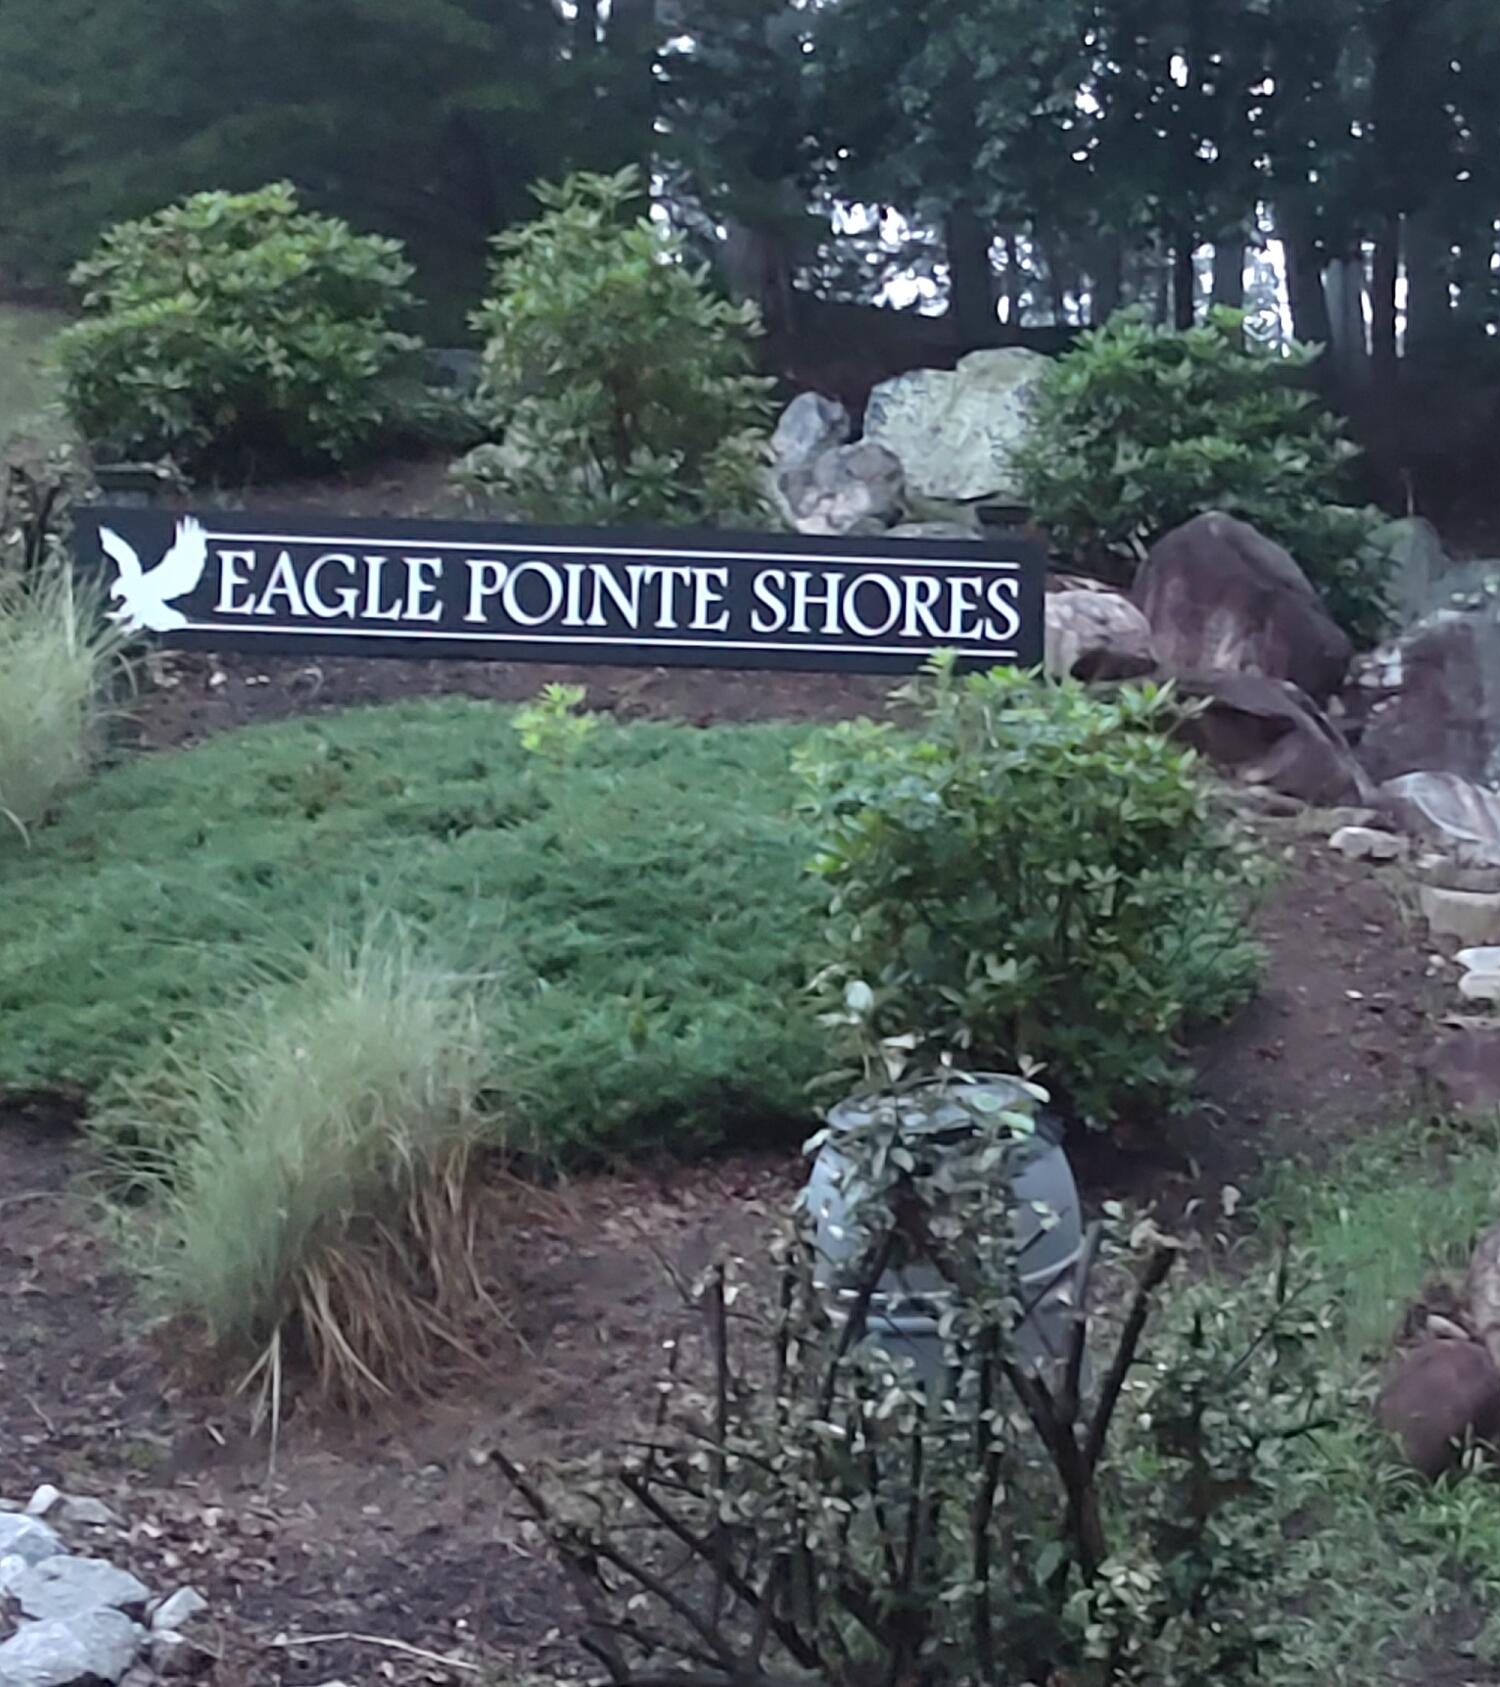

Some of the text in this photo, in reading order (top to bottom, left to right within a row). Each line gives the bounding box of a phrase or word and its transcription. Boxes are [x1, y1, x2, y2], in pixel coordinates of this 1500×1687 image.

[214, 549, 1020, 641] EAGLE POINTE SHORES
